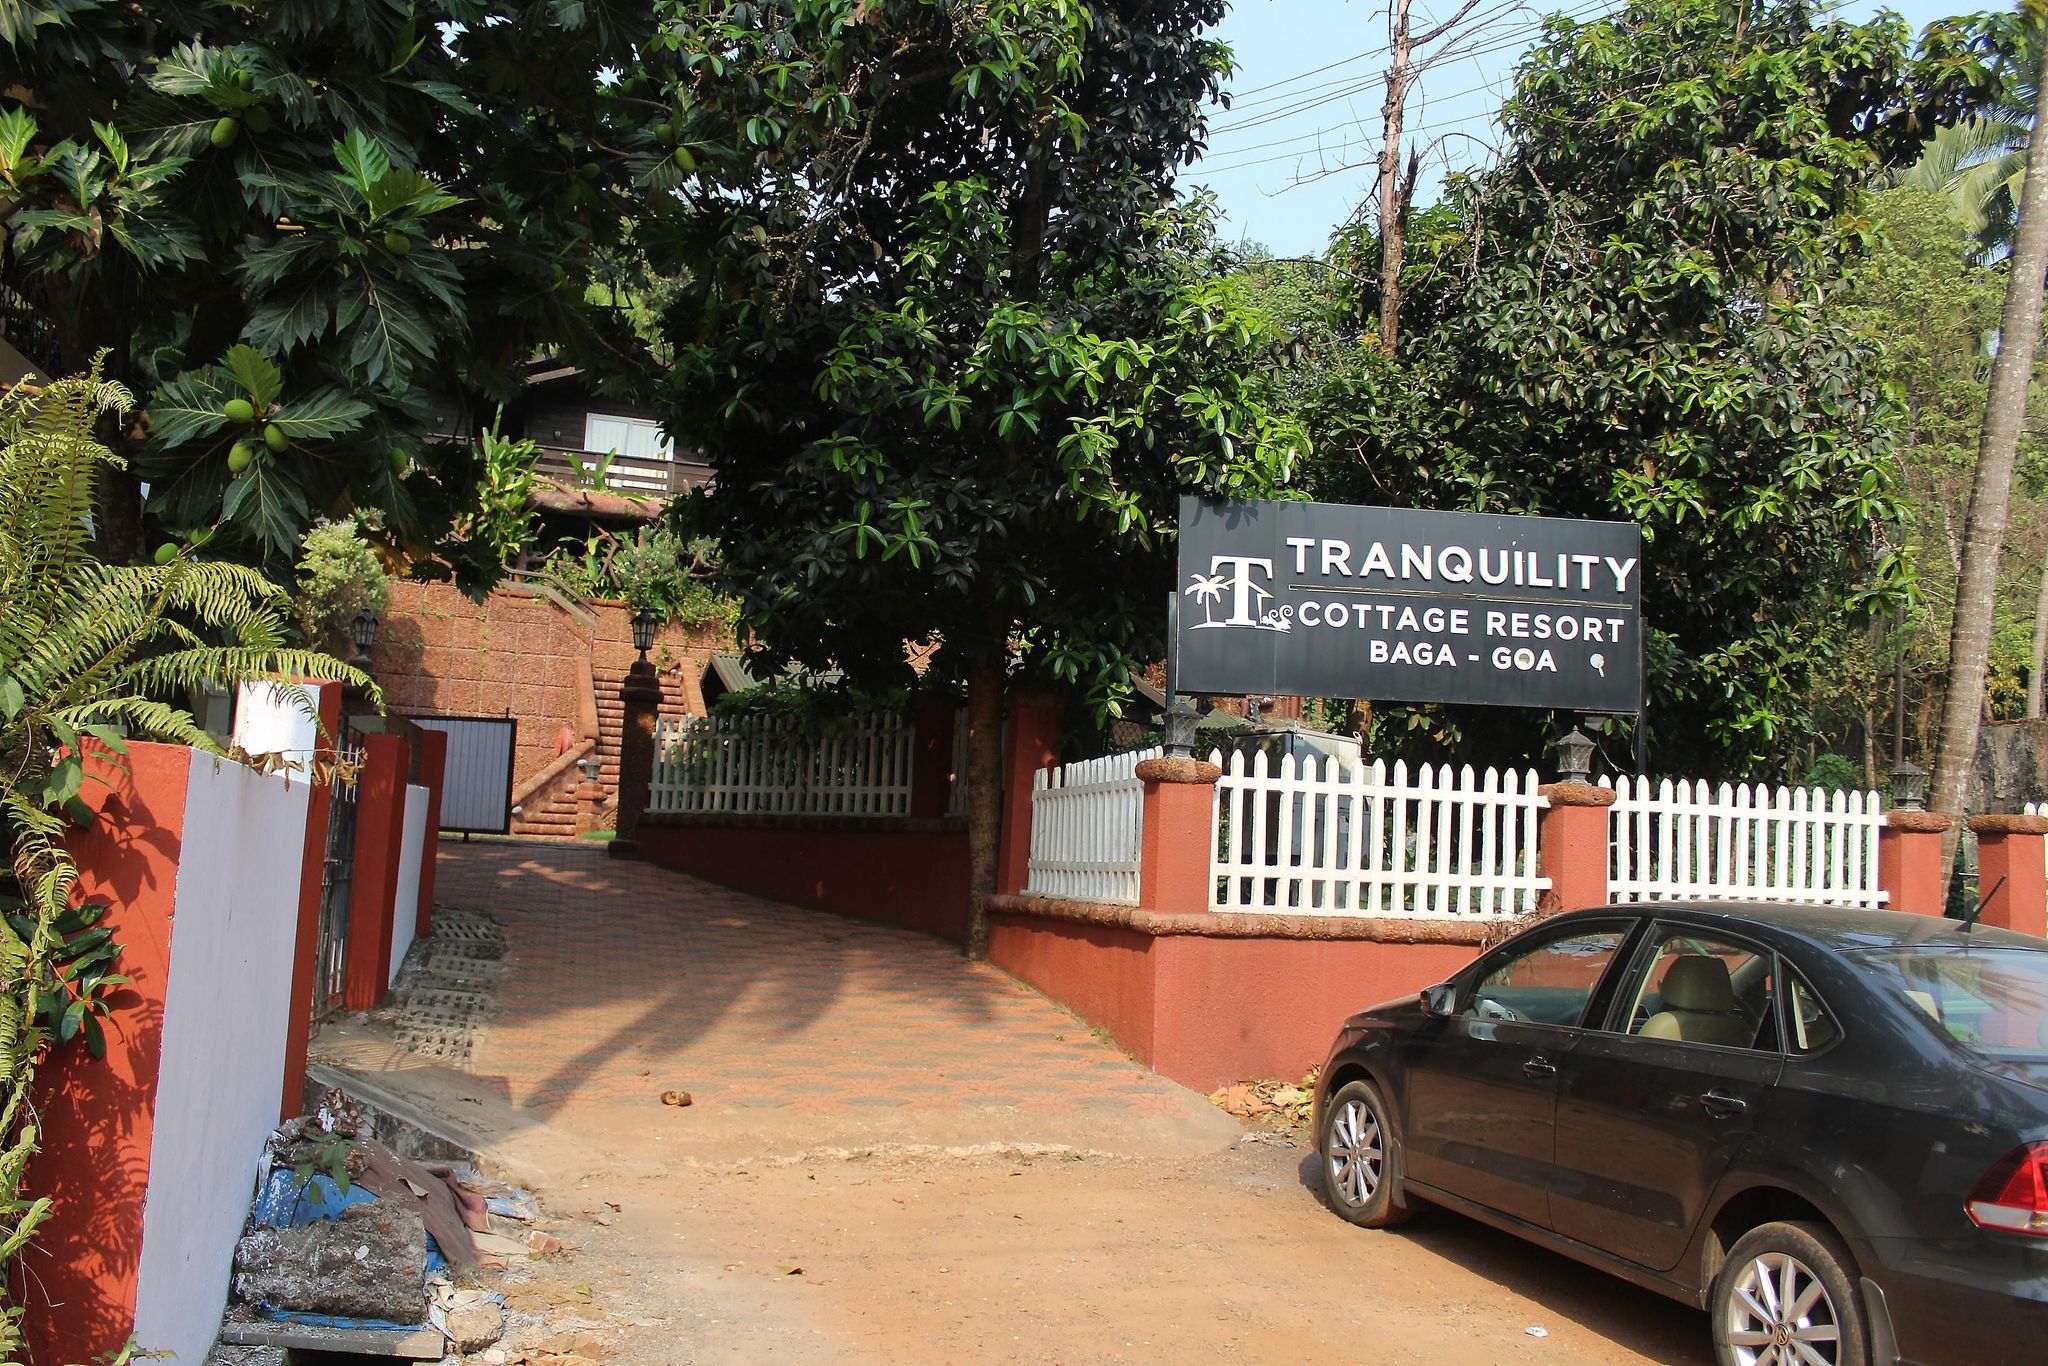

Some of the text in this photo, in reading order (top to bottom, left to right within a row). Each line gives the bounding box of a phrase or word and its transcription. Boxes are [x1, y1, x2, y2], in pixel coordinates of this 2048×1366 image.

[1286, 536, 1638, 593] TRANQUILITY
[1298, 600, 1626, 643] COTTAGE RESORT
[1369, 639, 1457, 667] BAGA
[1491, 646, 1558, 673] GOA
